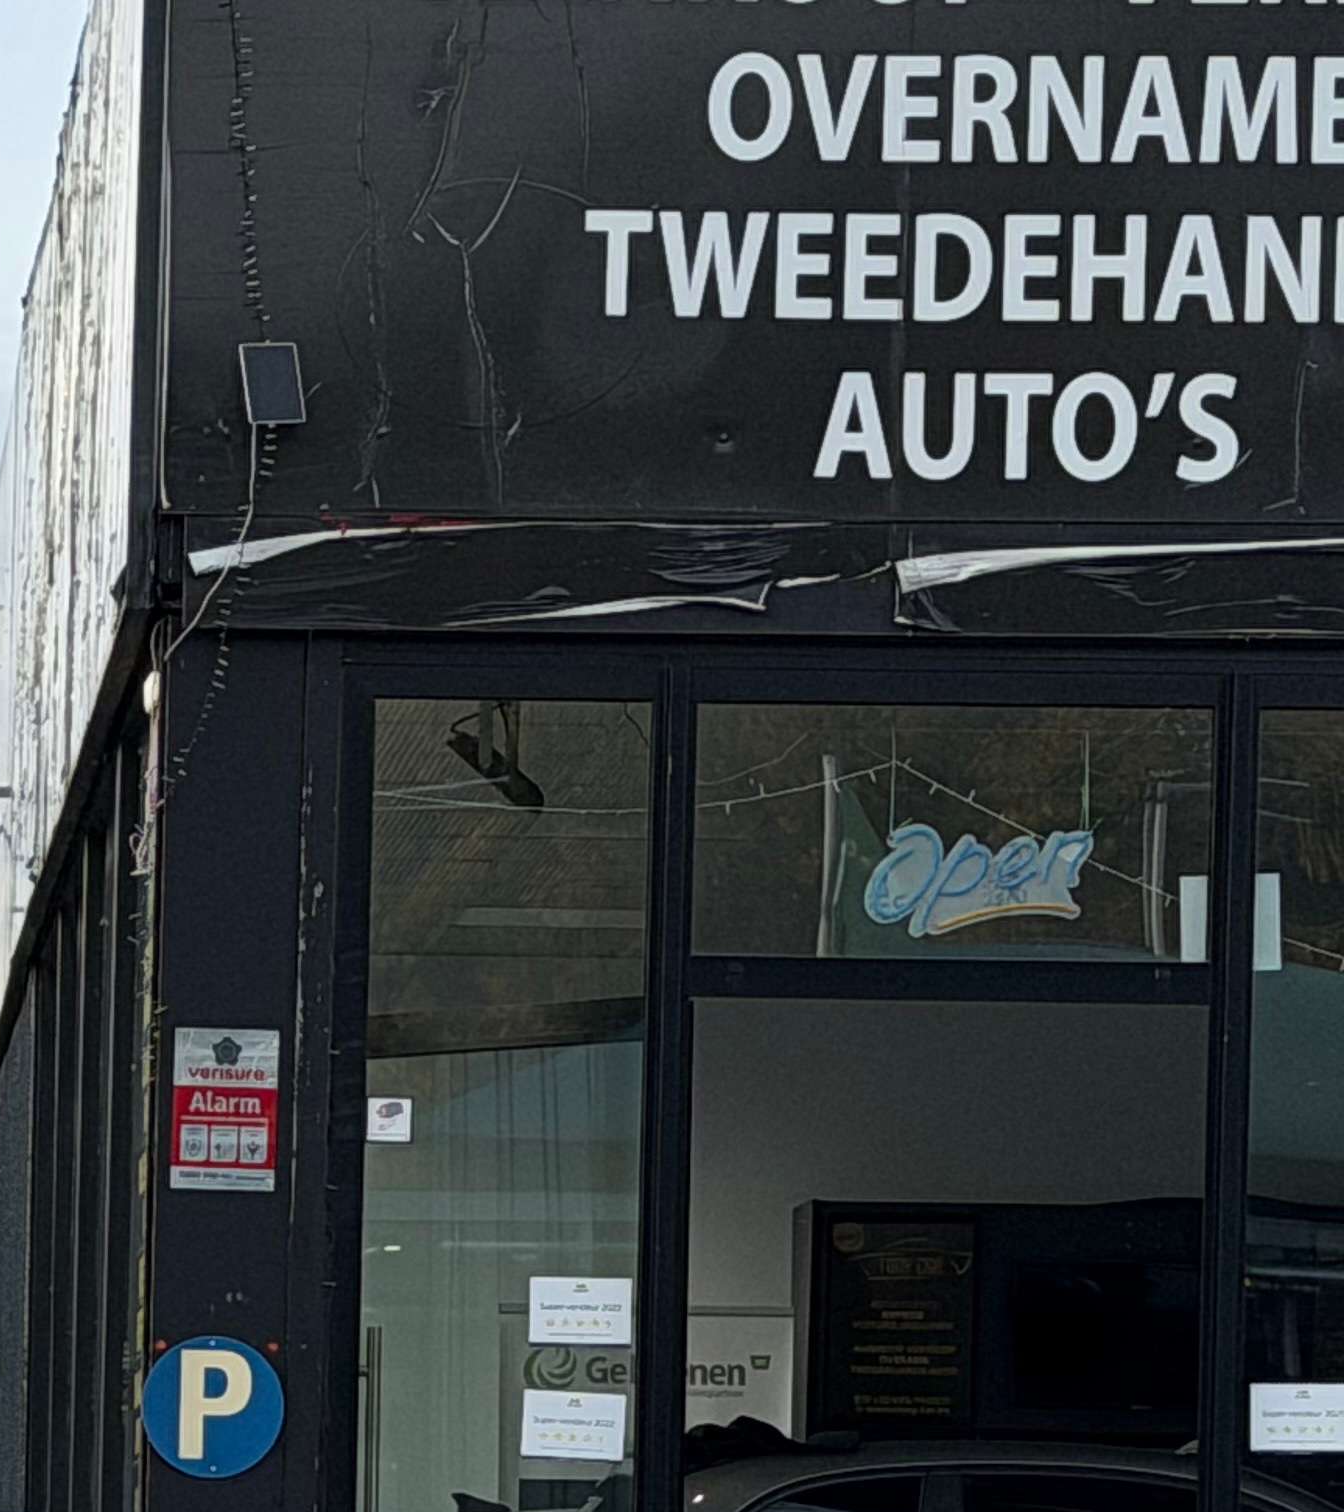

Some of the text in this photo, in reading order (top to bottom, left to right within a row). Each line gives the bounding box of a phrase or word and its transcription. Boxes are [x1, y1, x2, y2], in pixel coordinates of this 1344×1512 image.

[584, 209, 1344, 323] TWEEDEHAN
[813, 371, 1241, 483] AUTO'S
[867, 826, 1093, 934] Open
[188, 1090, 261, 1114] Alarm
[178, 1349, 253, 1460] P
